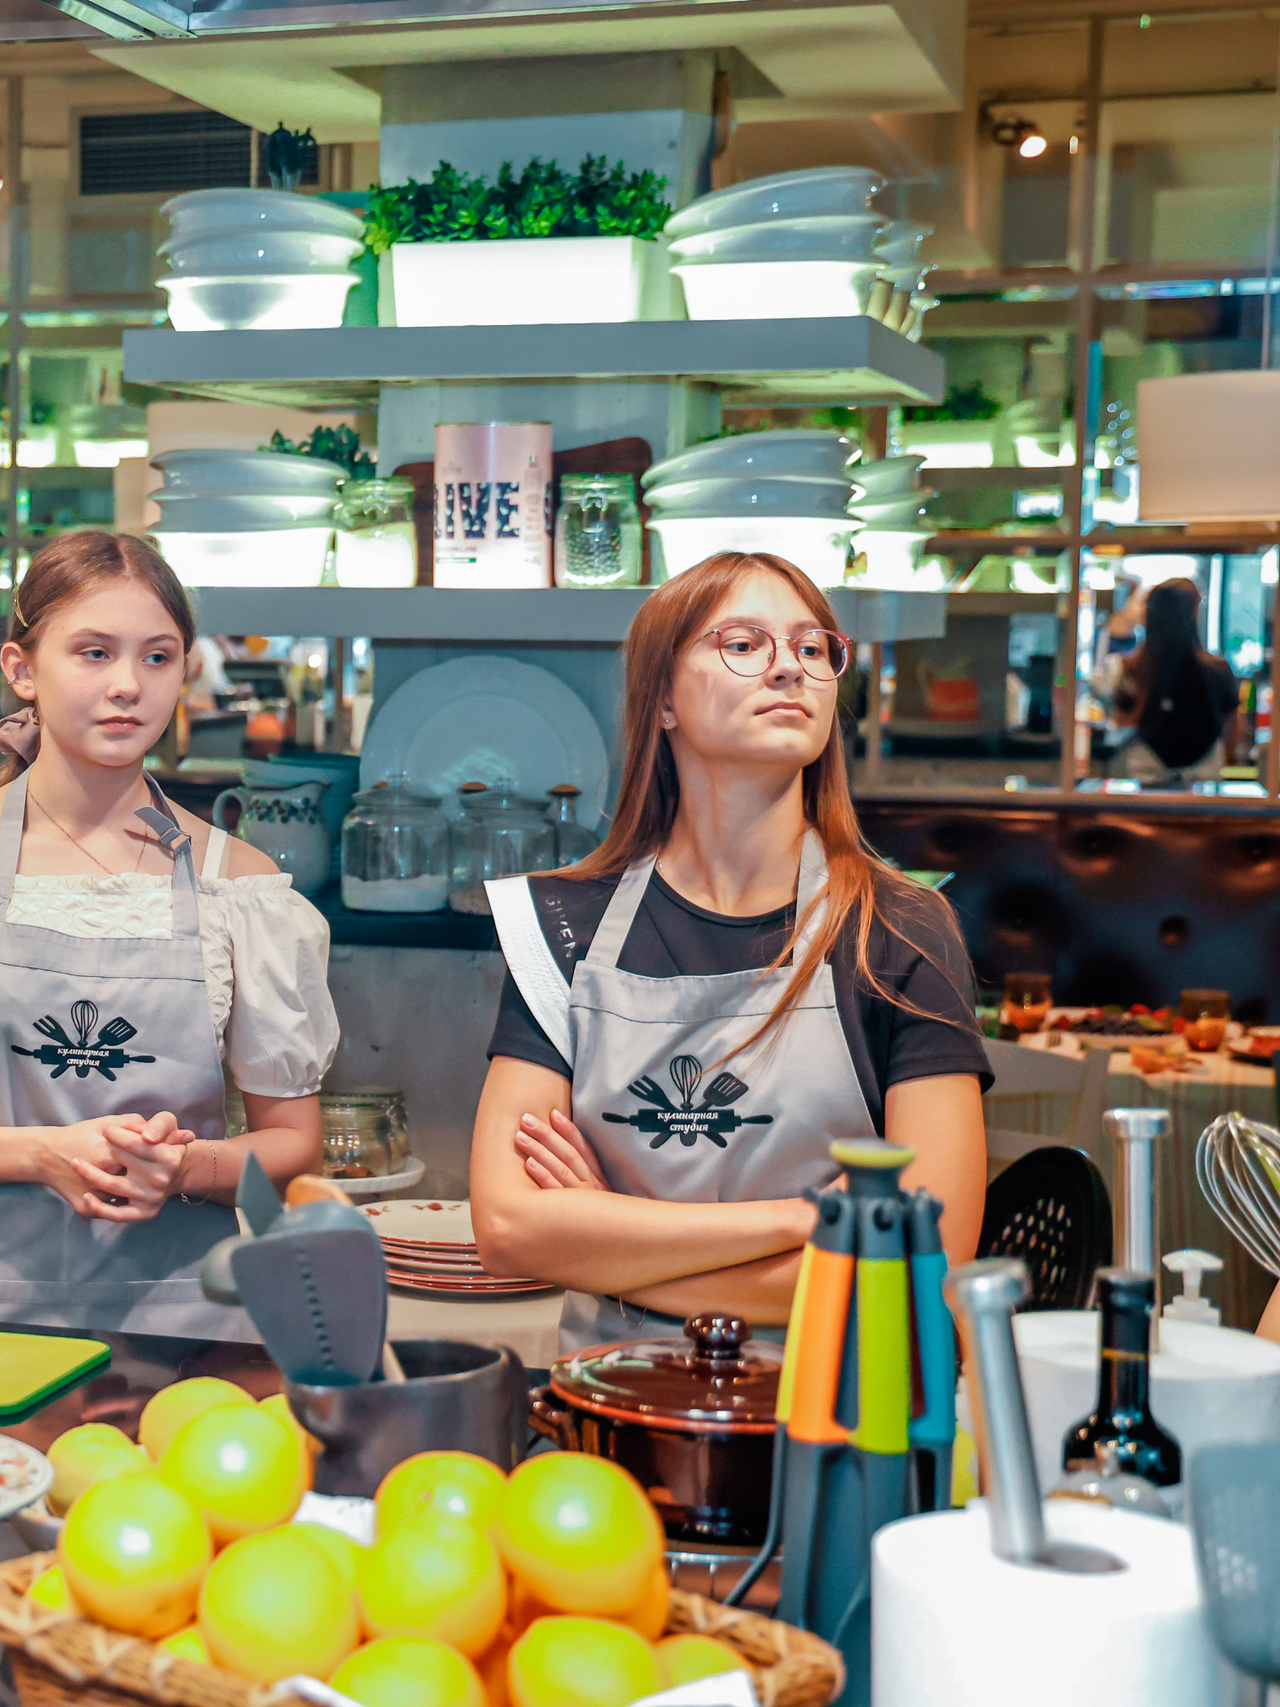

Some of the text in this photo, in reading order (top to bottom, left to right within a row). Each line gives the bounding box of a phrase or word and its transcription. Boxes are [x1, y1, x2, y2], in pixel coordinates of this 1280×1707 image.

[57, 1047, 110, 1058] кулинарная
[66, 1057, 100, 1067] студия
[657, 1112, 719, 1122] кулинарная
[669, 1122, 709, 1134] студия
